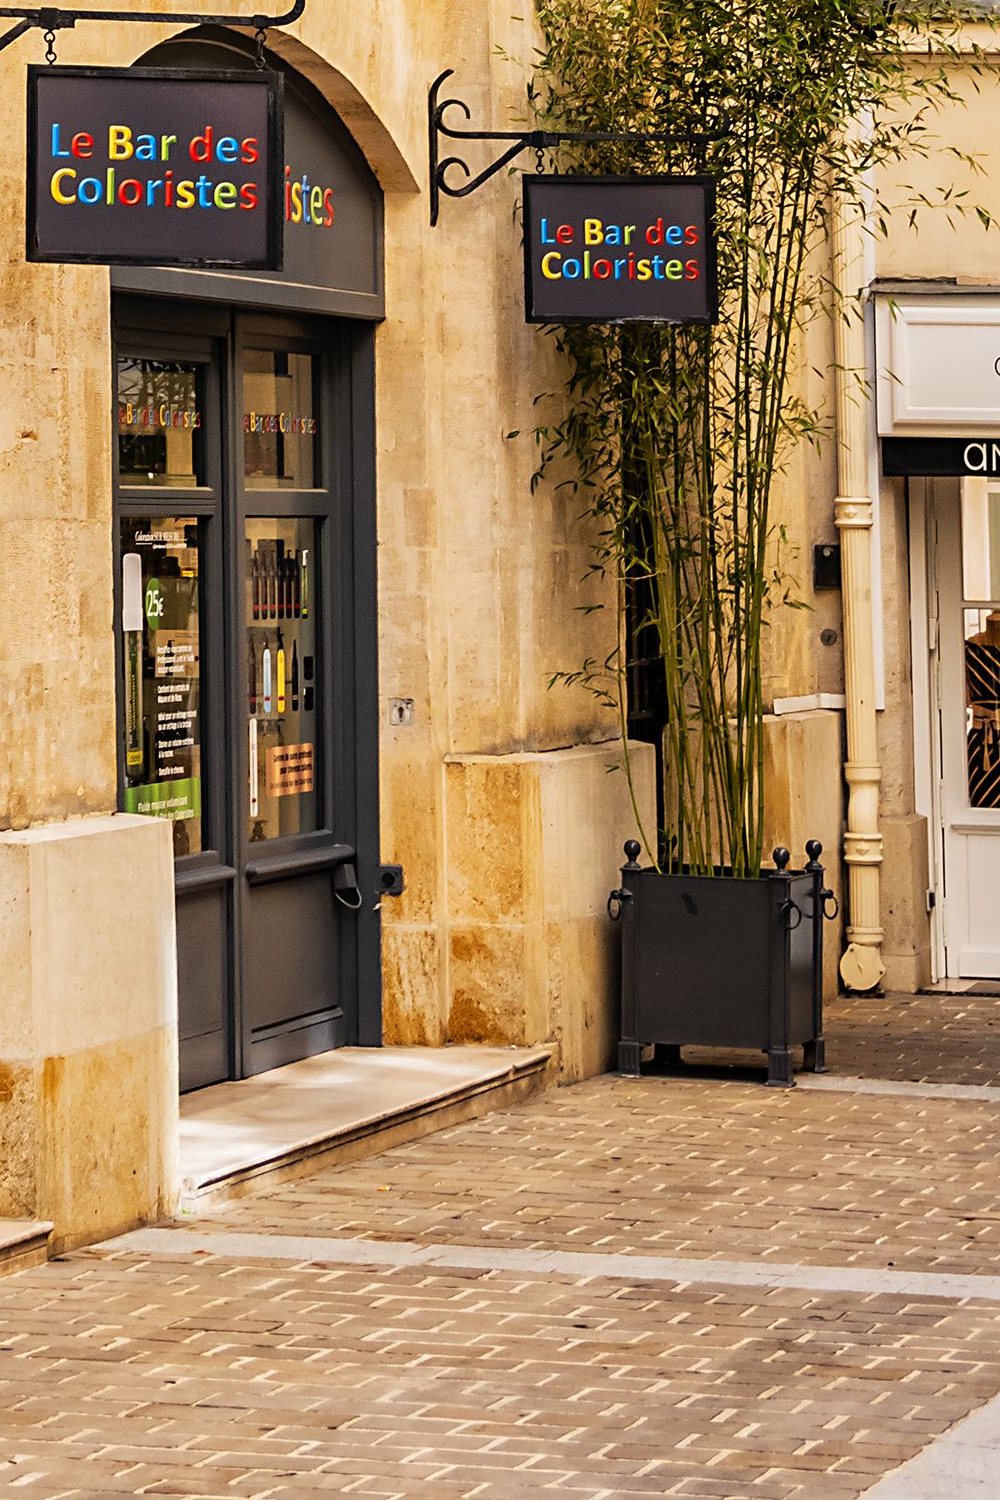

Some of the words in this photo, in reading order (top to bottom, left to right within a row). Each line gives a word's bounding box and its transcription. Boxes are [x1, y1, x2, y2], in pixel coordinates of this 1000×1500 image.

[51, 123, 94, 159] Le
[108, 126, 178, 161] Bar
[189, 125, 260, 165] des
[50, 167, 259, 211] Coloristes
[541, 218, 573, 245] Le
[583, 218, 636, 246] Bar
[645, 217, 699, 247] des
[541, 250, 700, 282] Coloristes
[147, 590, 164, 617] 25€
